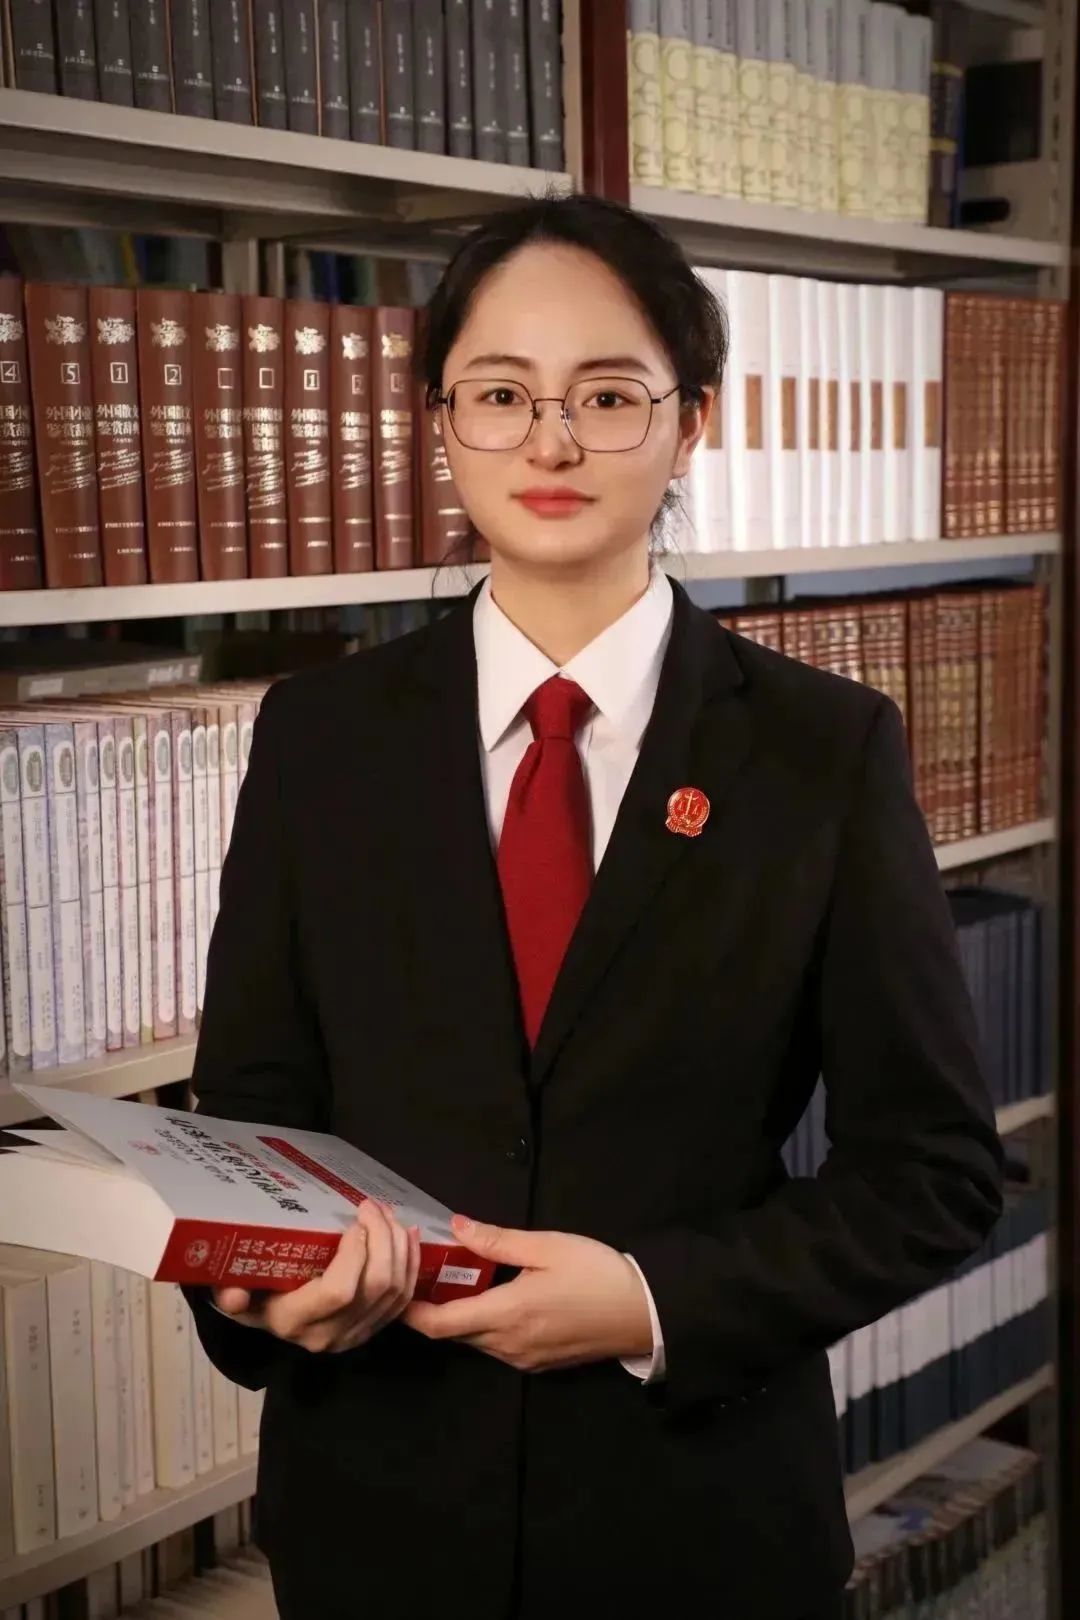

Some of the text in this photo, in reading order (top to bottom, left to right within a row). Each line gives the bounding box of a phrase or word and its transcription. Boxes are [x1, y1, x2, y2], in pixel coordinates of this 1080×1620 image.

[5, 363, 17, 381] 4
[66, 365, 76, 382] 5
[116, 367, 123, 380] 1
[169, 368, 179, 382] 2
